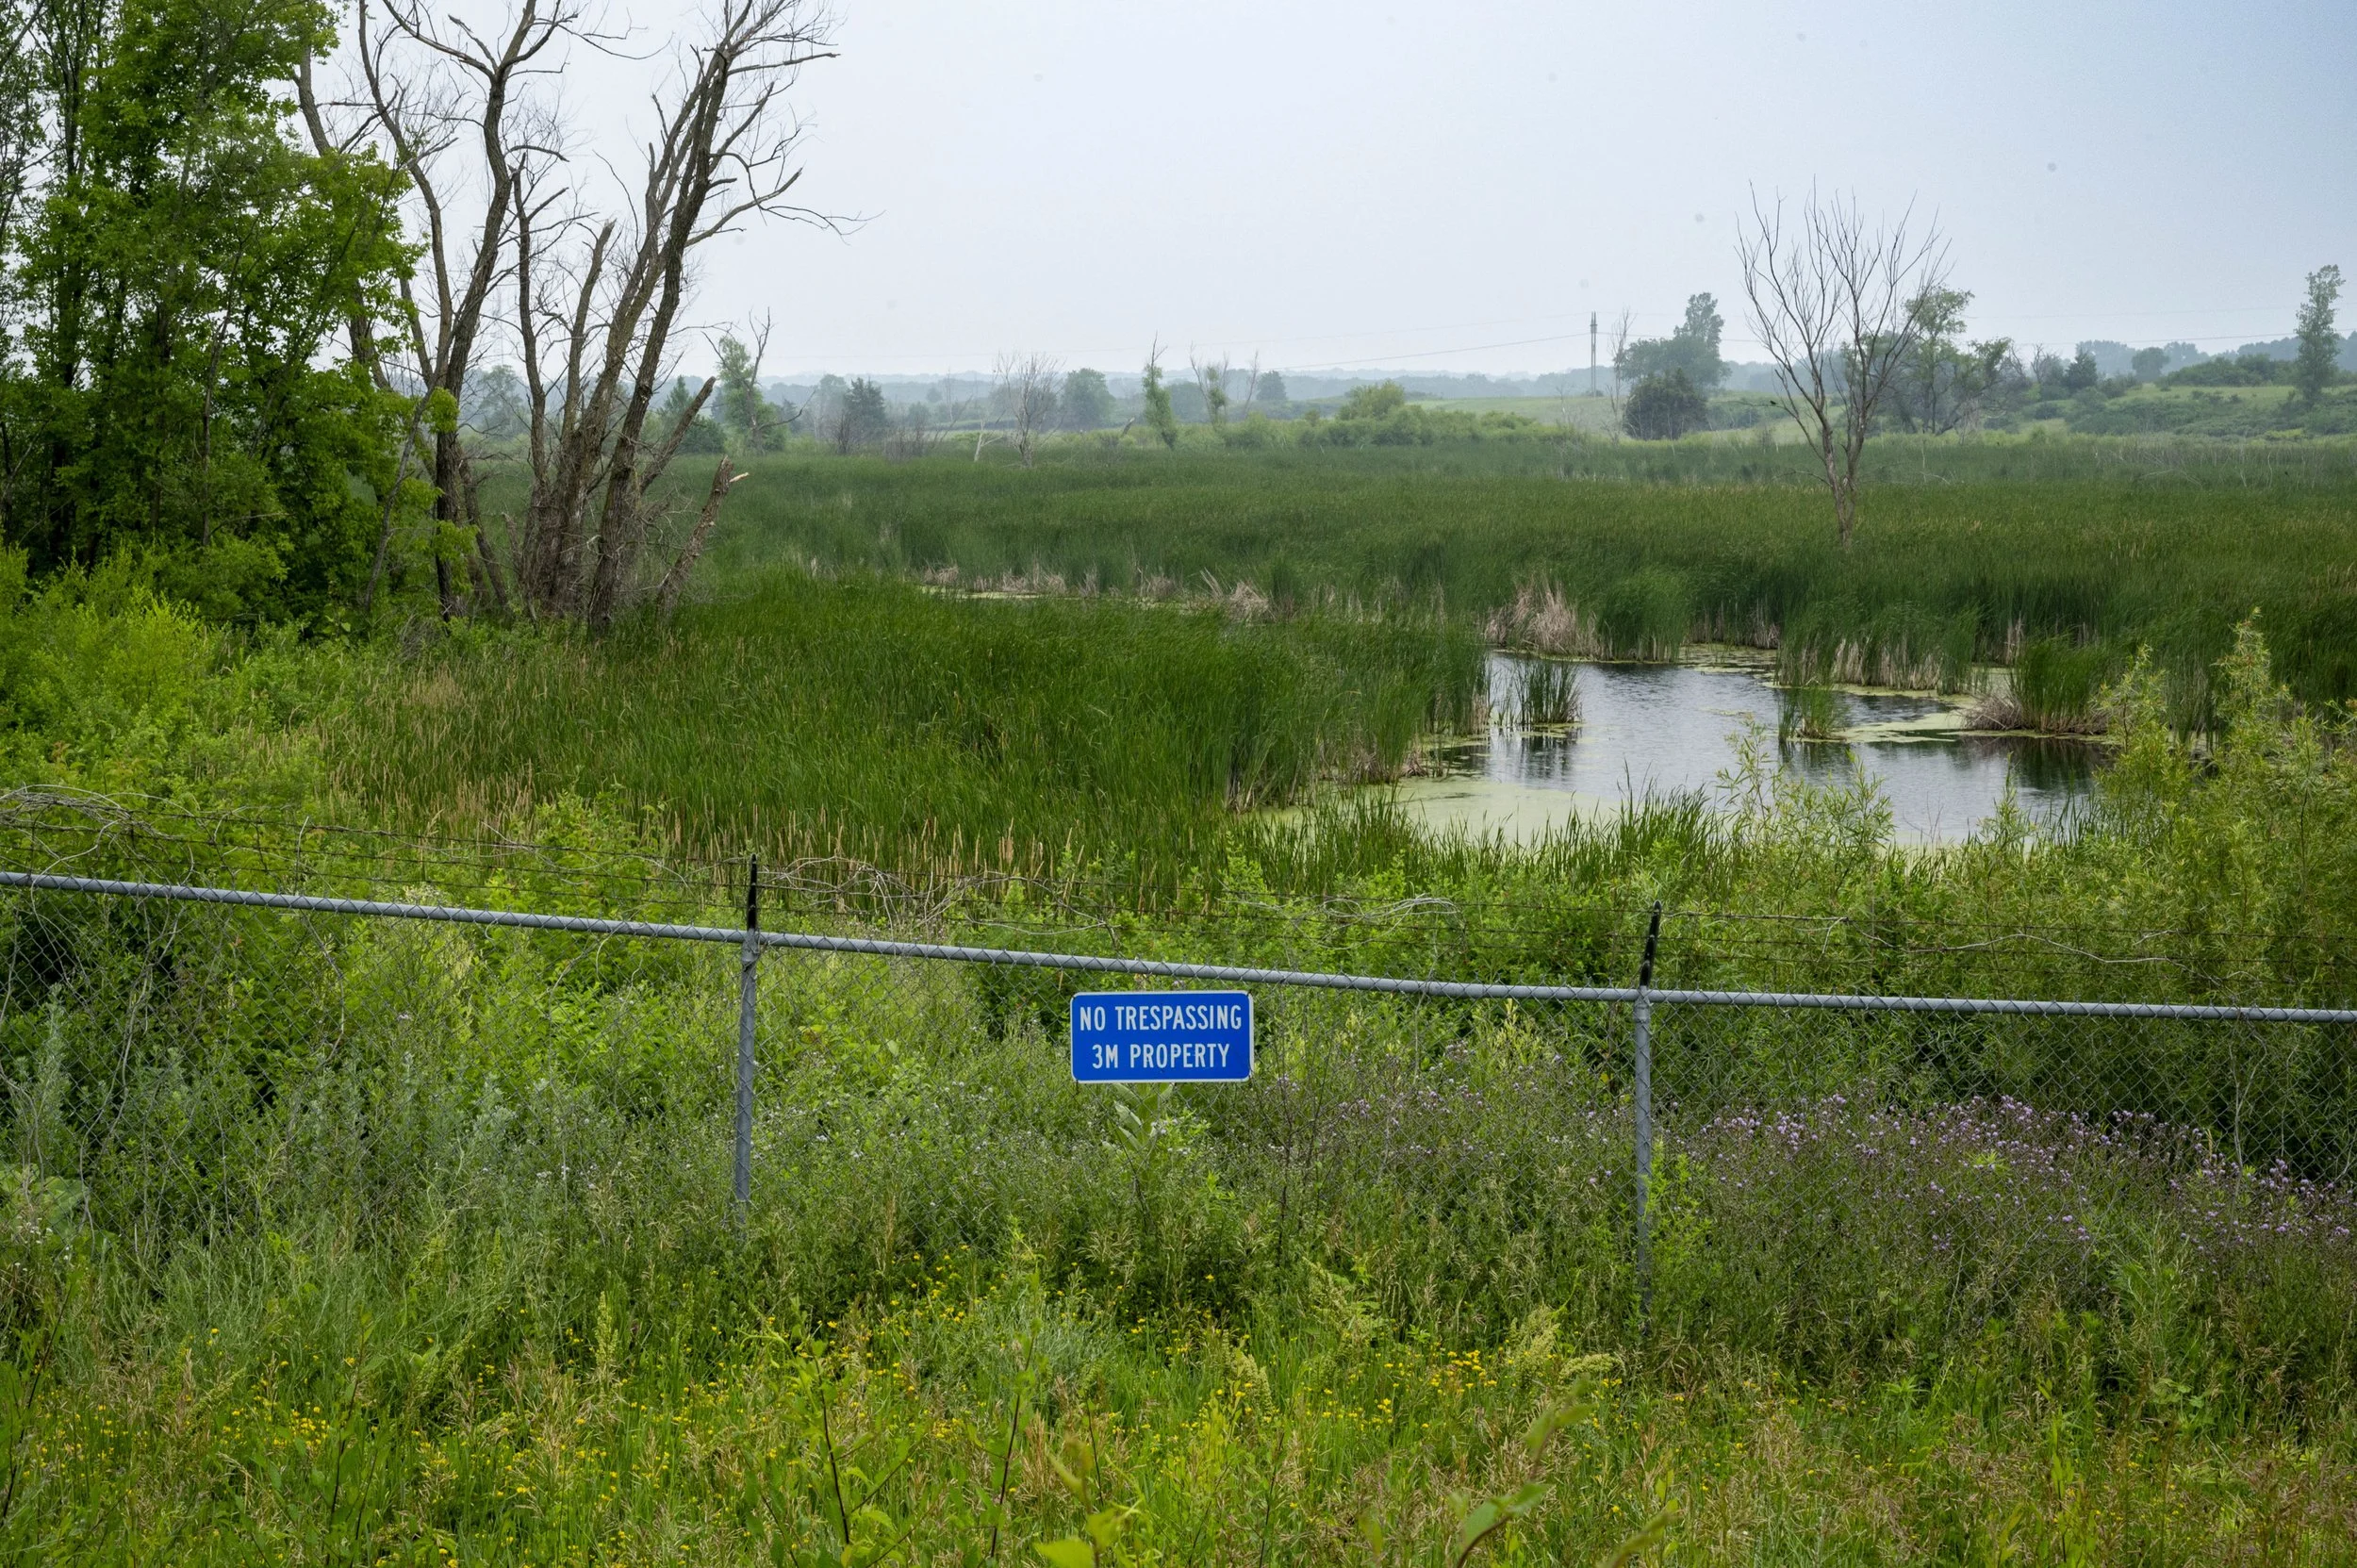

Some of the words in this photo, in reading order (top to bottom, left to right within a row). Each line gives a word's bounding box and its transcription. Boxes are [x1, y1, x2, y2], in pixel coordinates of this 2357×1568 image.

[1080, 1006, 1106, 1032] NO
[1115, 1005, 1242, 1031] TRESPASSING
[1092, 1044, 1119, 1069] 3M
[1129, 1043, 1230, 1068] PROPERTY
